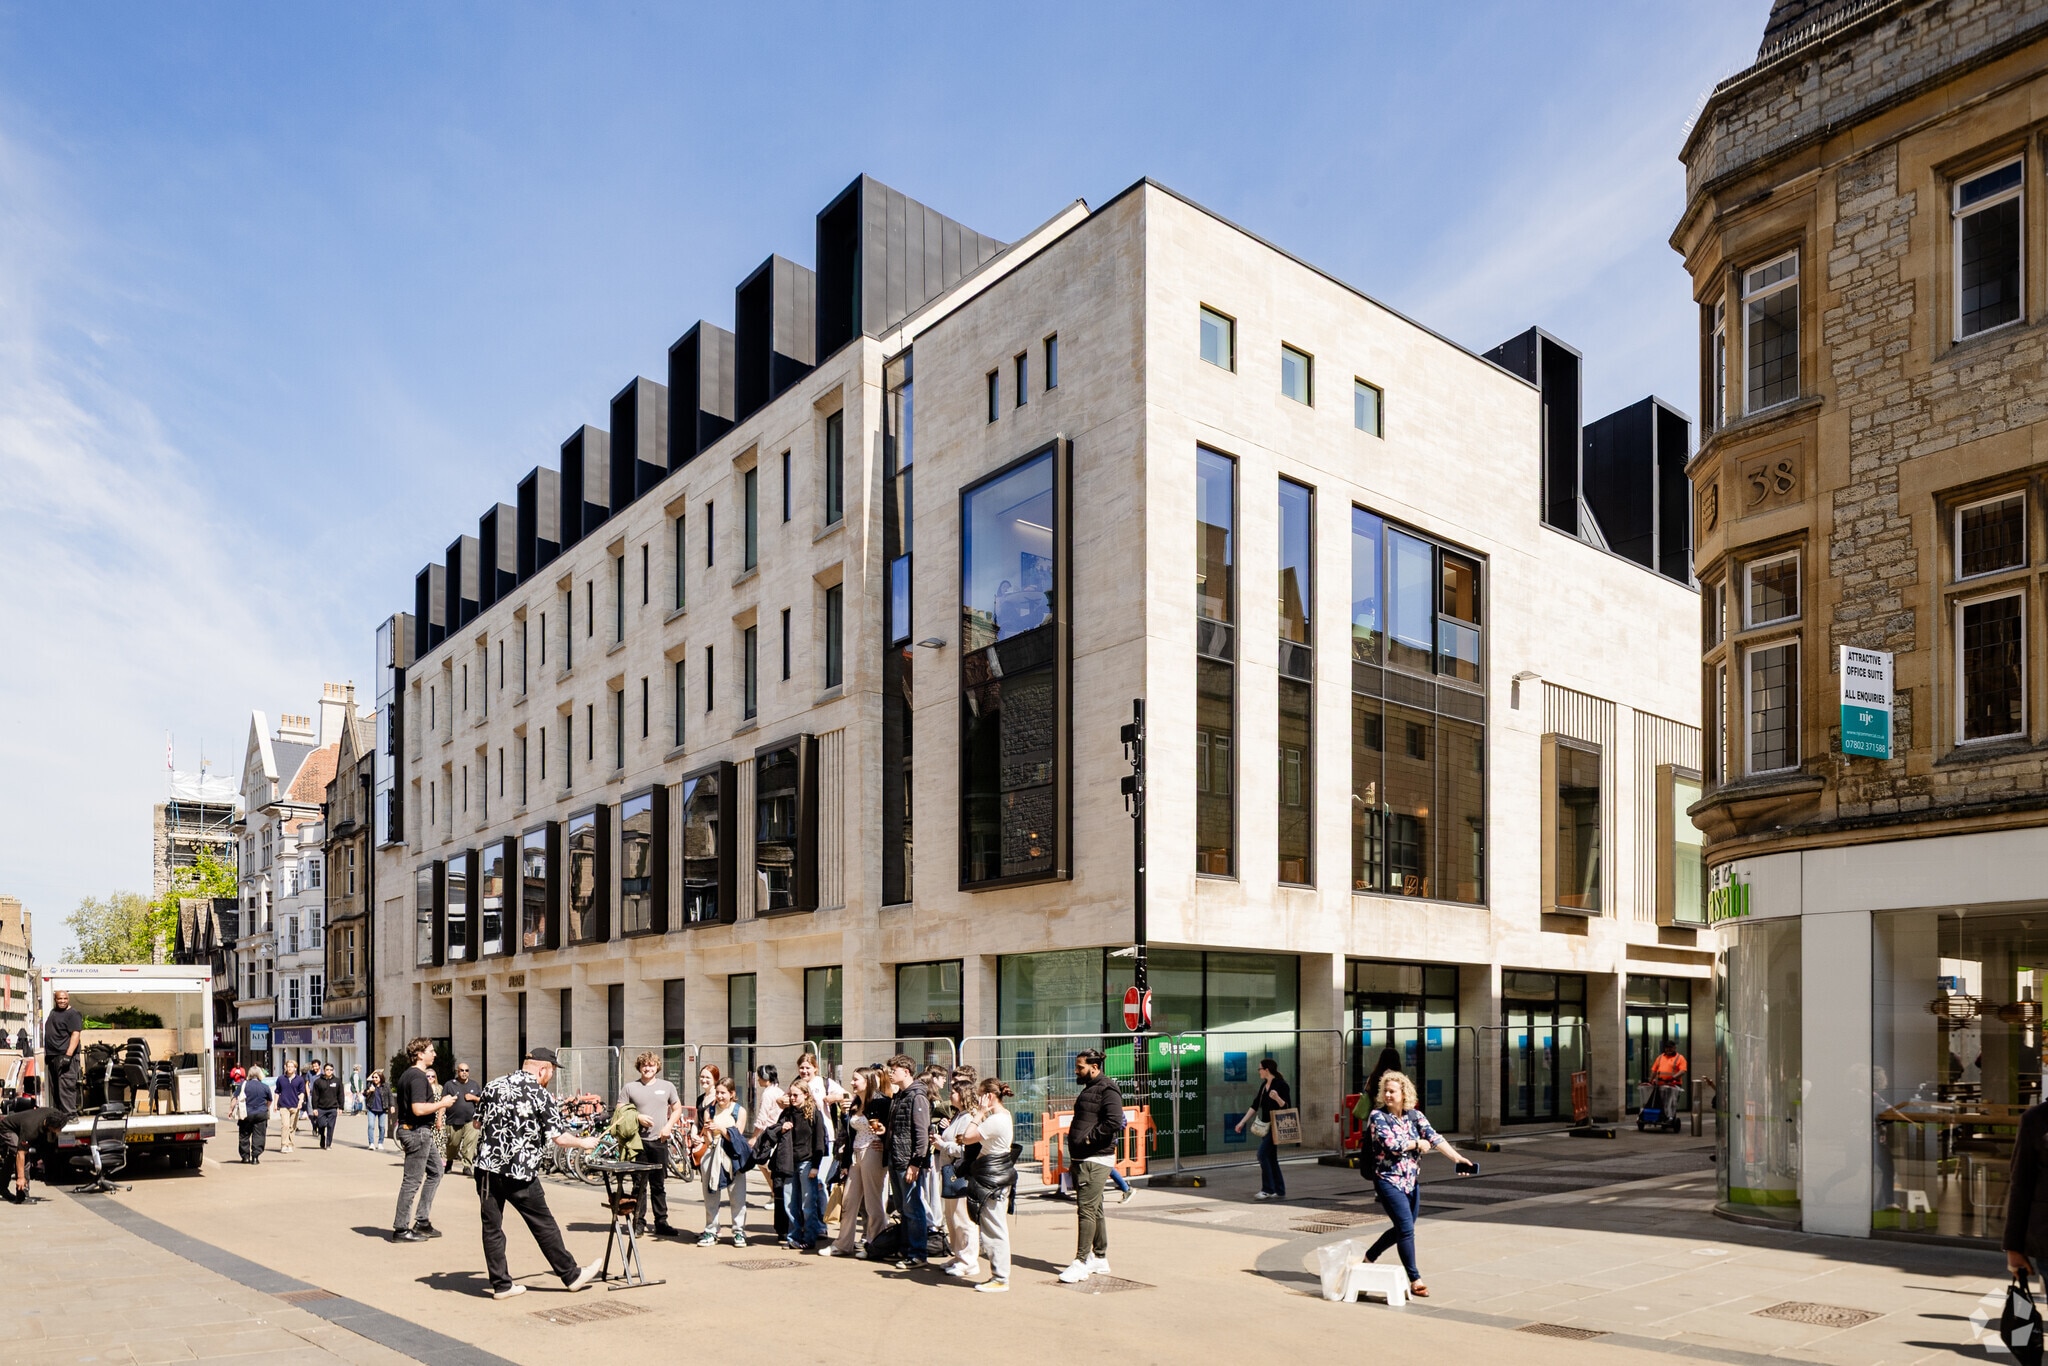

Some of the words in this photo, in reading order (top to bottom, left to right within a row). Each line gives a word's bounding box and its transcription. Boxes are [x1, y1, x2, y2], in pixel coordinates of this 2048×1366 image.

[1747, 459, 1796, 506] 38
[1848, 651, 1881, 665] ATTRACTIVE
[1847, 666, 1866, 677] OFFICE
[1868, 669, 1883, 680] SUITE
[1845, 689, 1856, 699] ALL
[1857, 691, 1885, 704] ENQUIRIES
[1859, 711, 1873, 726] njc
[1845, 740, 1864, 750] 07802
[1186, 1077, 1198, 1086] and
[1151, 1091, 1162, 1099] the
